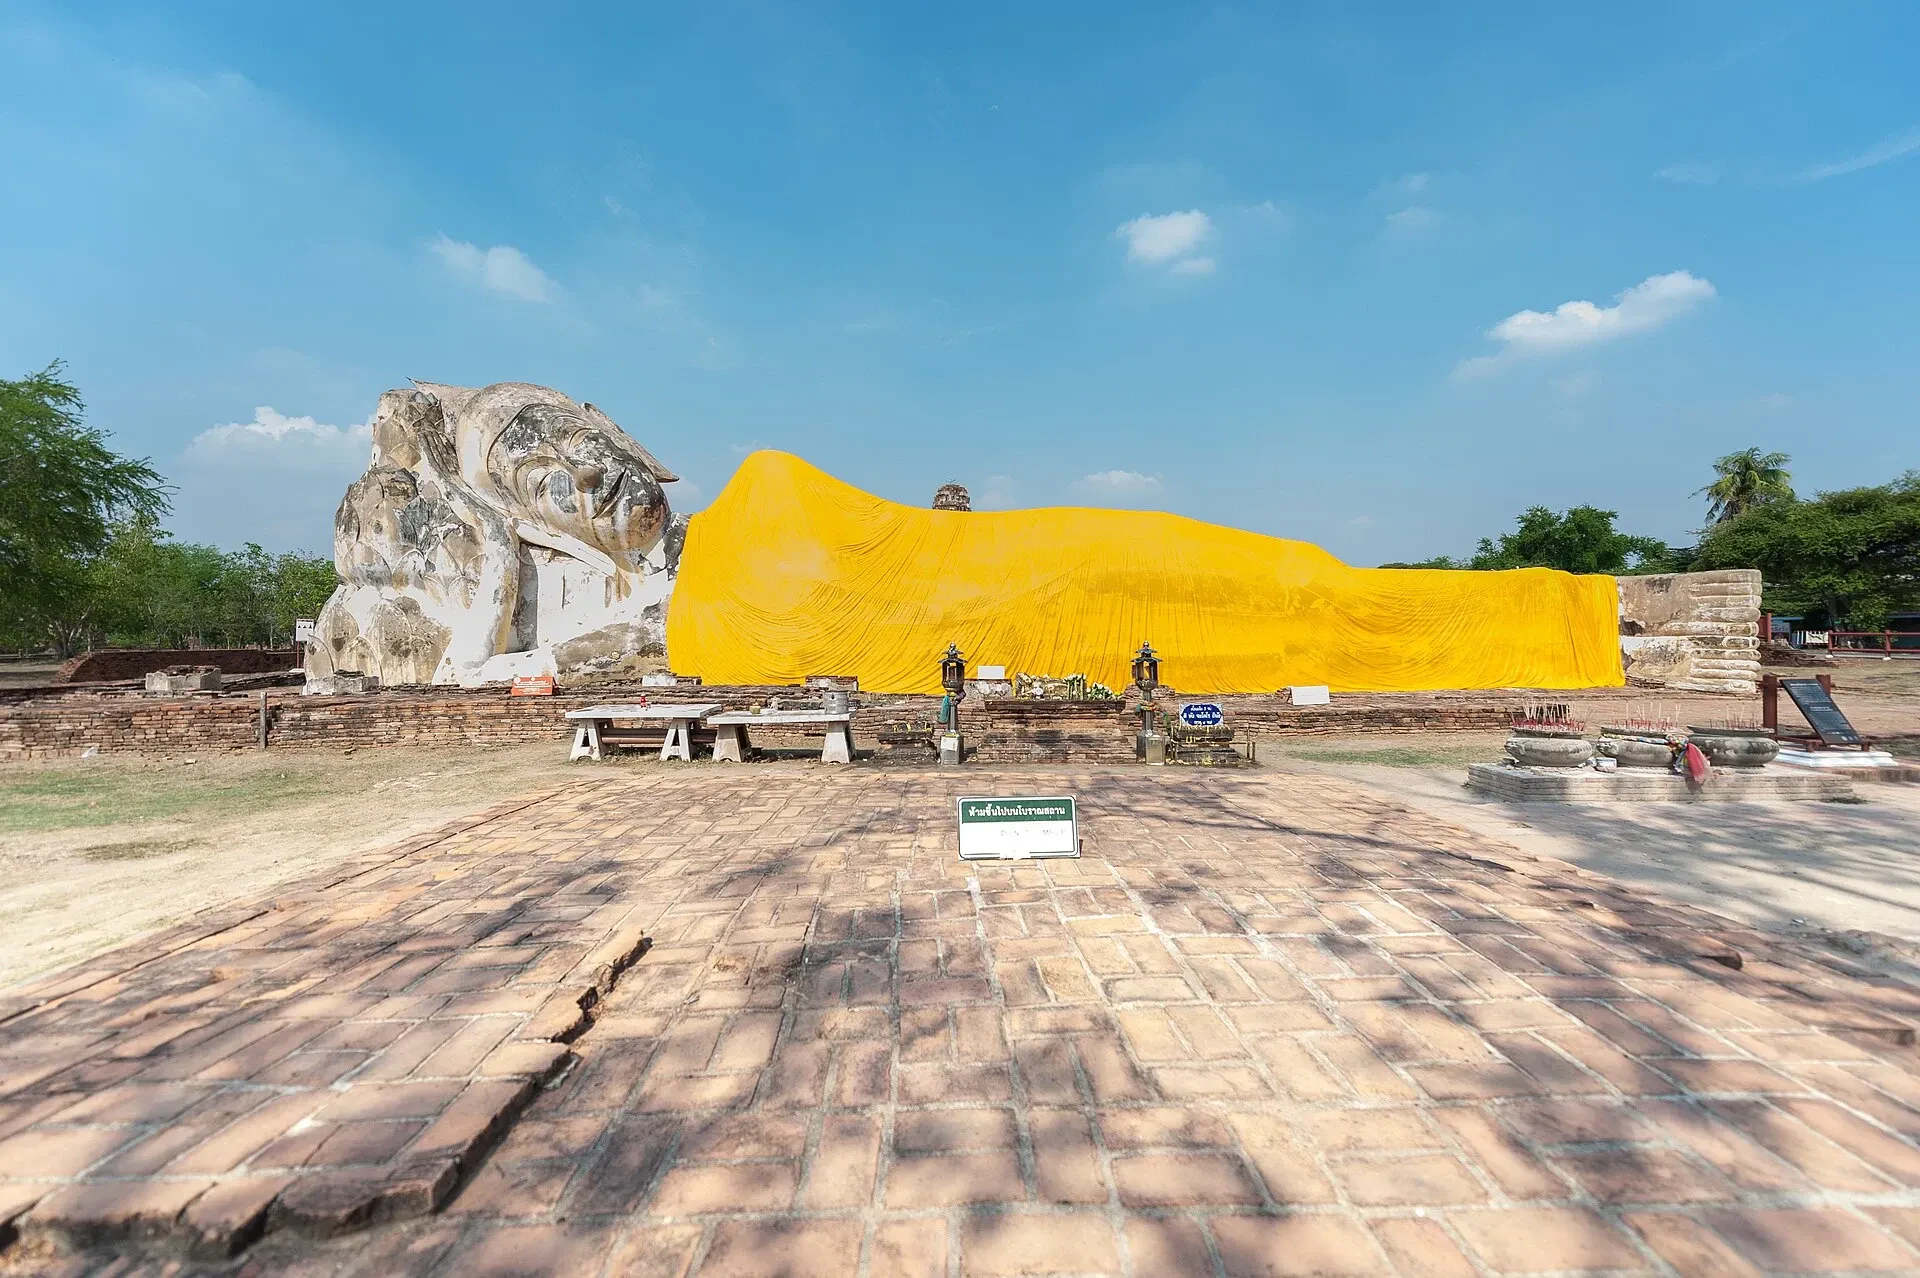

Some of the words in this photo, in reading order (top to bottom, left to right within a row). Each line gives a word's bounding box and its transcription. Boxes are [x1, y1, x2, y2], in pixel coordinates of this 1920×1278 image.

[968, 804, 1065, 816] ห้ามขึ้นไปบนโบราณสถาน
